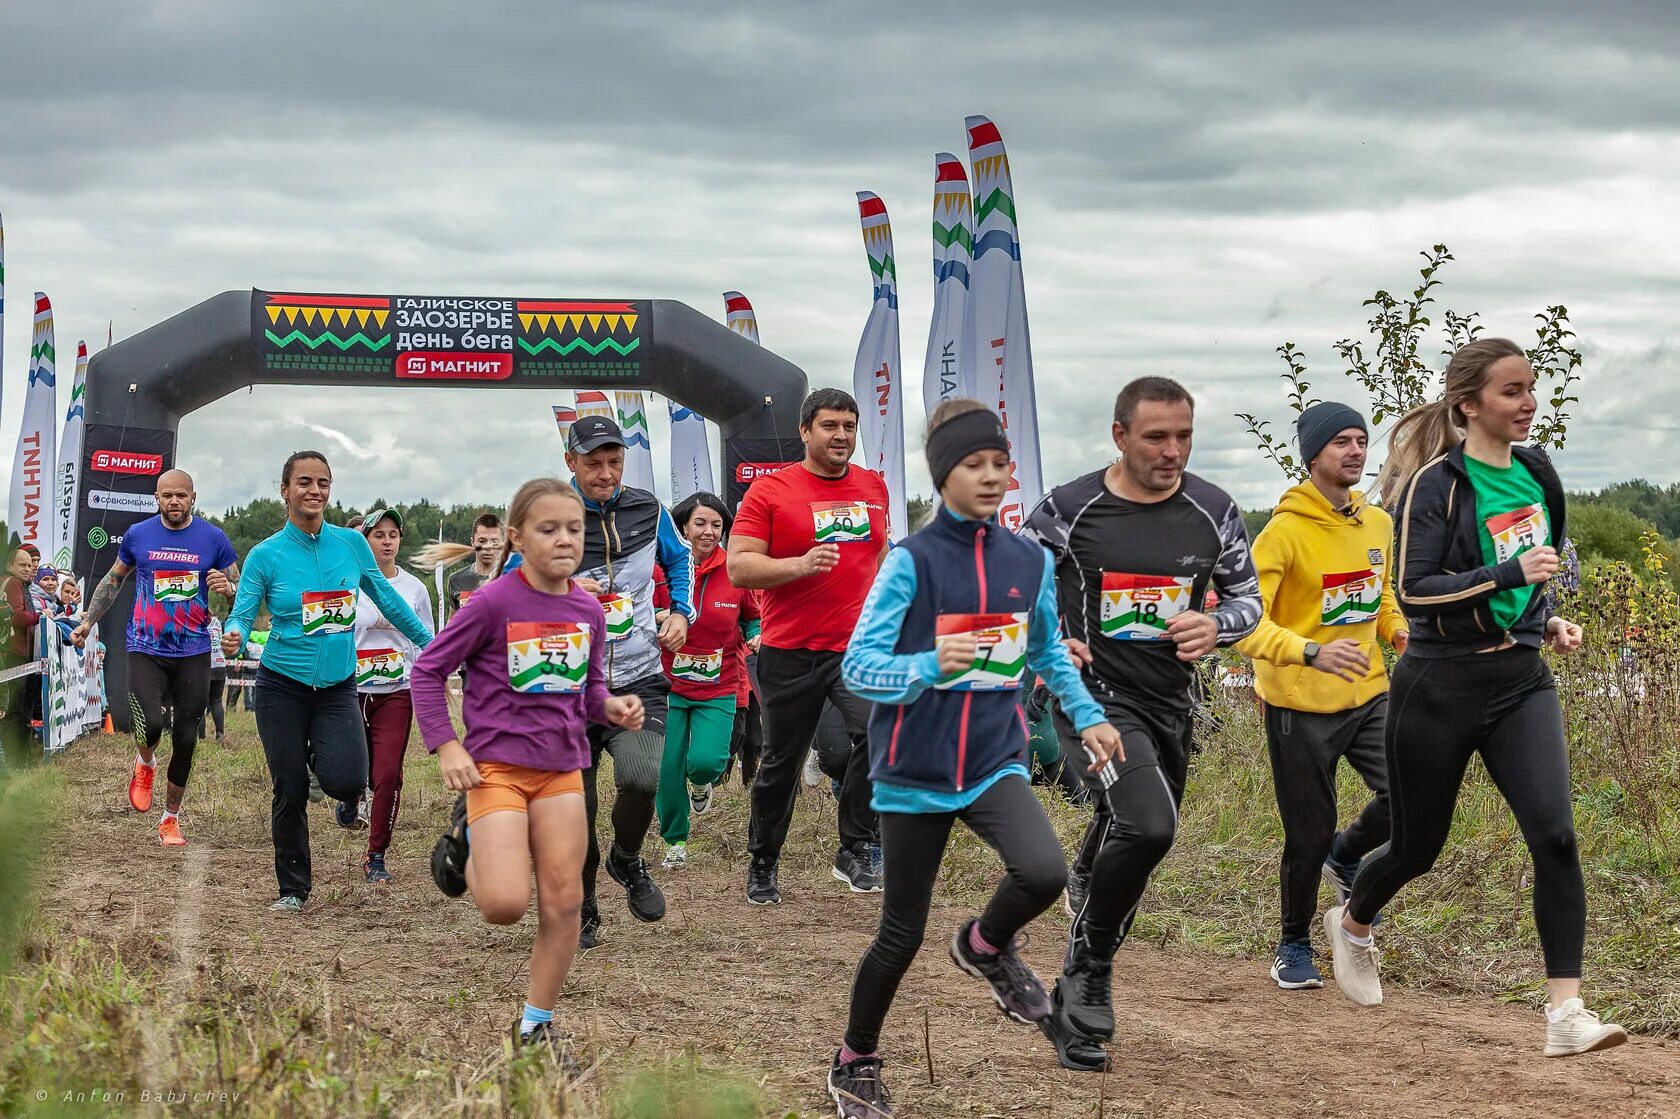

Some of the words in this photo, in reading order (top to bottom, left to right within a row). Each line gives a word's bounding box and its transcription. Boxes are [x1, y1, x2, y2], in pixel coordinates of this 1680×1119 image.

[397, 299, 513, 311] ГАЛИЧСКОЕ
[396, 310, 513, 330] ЗАОЗЕРЬЕ
[396, 332, 455, 351] день
[461, 329, 513, 350] бега
[430, 360, 502, 373] МАГНИТ
[111, 457, 157, 469] МАГНИТ
[100, 496, 155, 507] СОВКОМБАНК
[832, 517, 853, 532] 60
[152, 551, 198, 562] ПЛАНБЕГ
[170, 583, 183, 595] 21
[1347, 592, 1362, 611] 11
[323, 608, 344, 624] 26
[1131, 602, 1158, 625] 18
[540, 652, 569, 676] 33
[978, 646, 993, 671] 7
[371, 663, 390, 677] 46
[689, 662, 708, 675] 48
